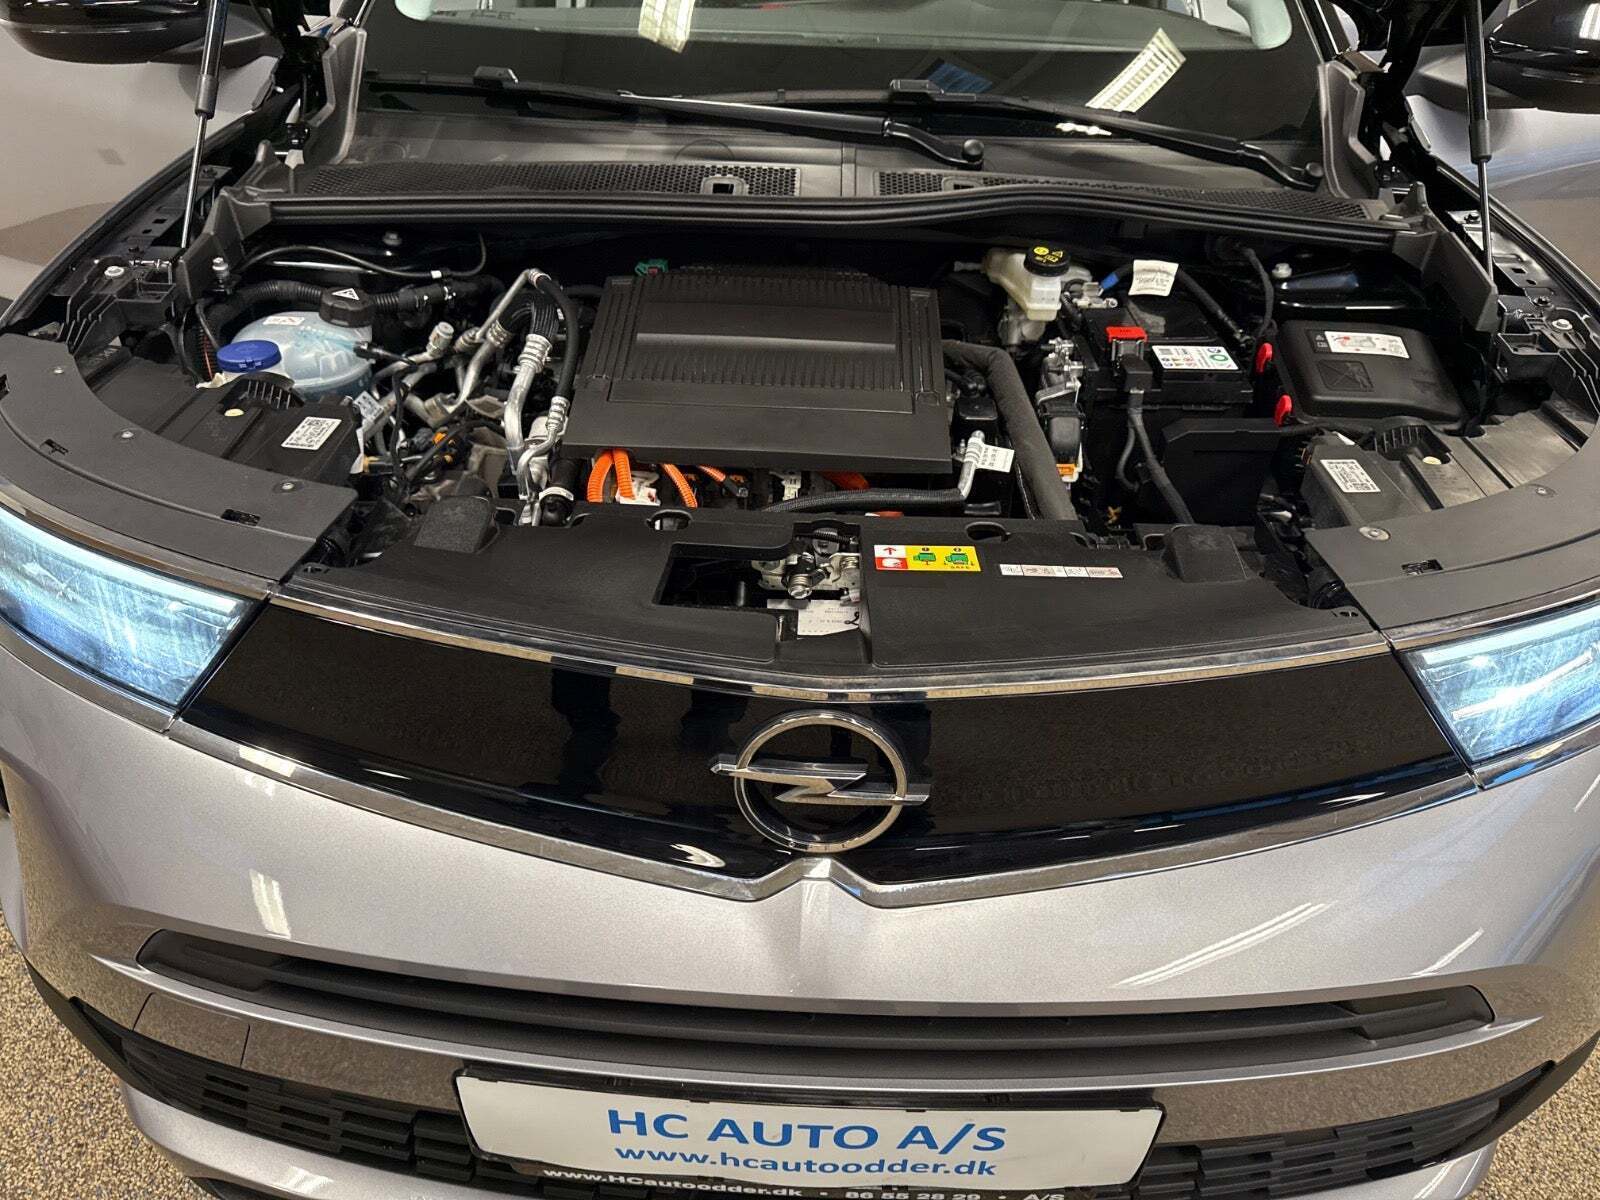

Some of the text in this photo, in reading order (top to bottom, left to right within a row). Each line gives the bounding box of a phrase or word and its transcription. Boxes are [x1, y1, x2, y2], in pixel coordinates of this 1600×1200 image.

[607, 1109, 1006, 1155] HC AUTO A/S
[615, 1147, 997, 1176] www.hcautoodder.dk
[543, 1168, 804, 1197] www.HCautoodder.dk
